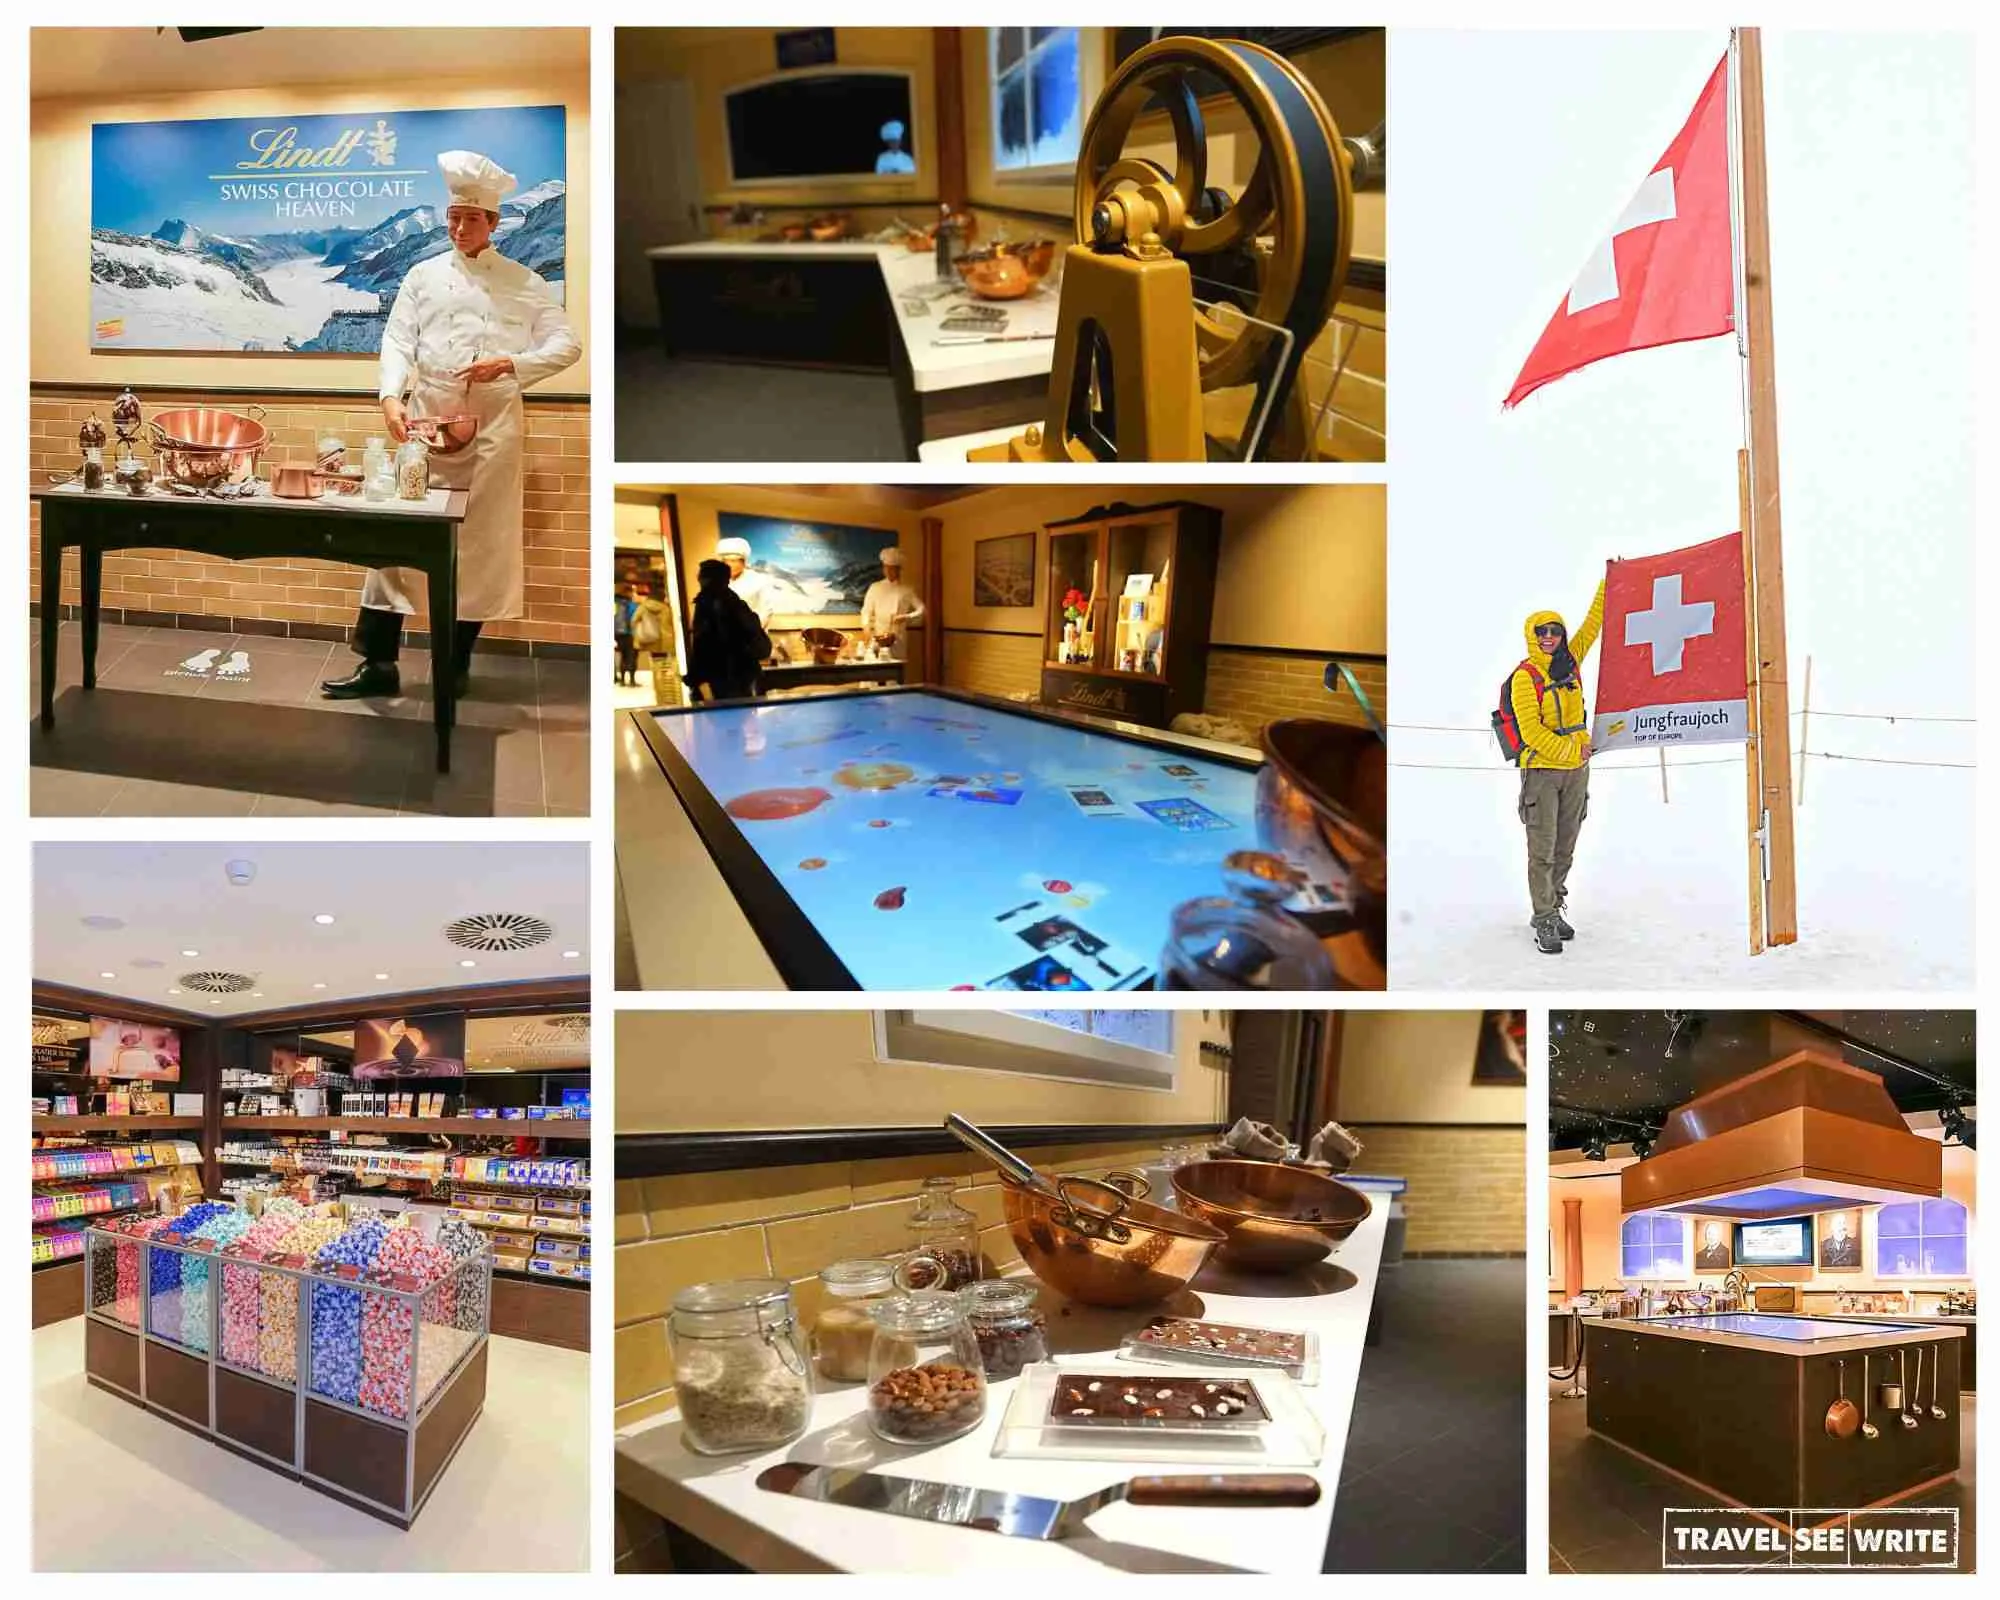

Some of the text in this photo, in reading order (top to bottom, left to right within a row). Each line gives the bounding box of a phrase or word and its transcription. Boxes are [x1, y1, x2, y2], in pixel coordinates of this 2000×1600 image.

[236, 127, 365, 170] Lindt
[220, 180, 415, 201] SWISS CHOCOLATE
[274, 200, 356, 219] HEAVEN
[1633, 707, 1729, 733] Jungfraujoch
[1634, 732, 1683, 743] TOP OF EUROPE
